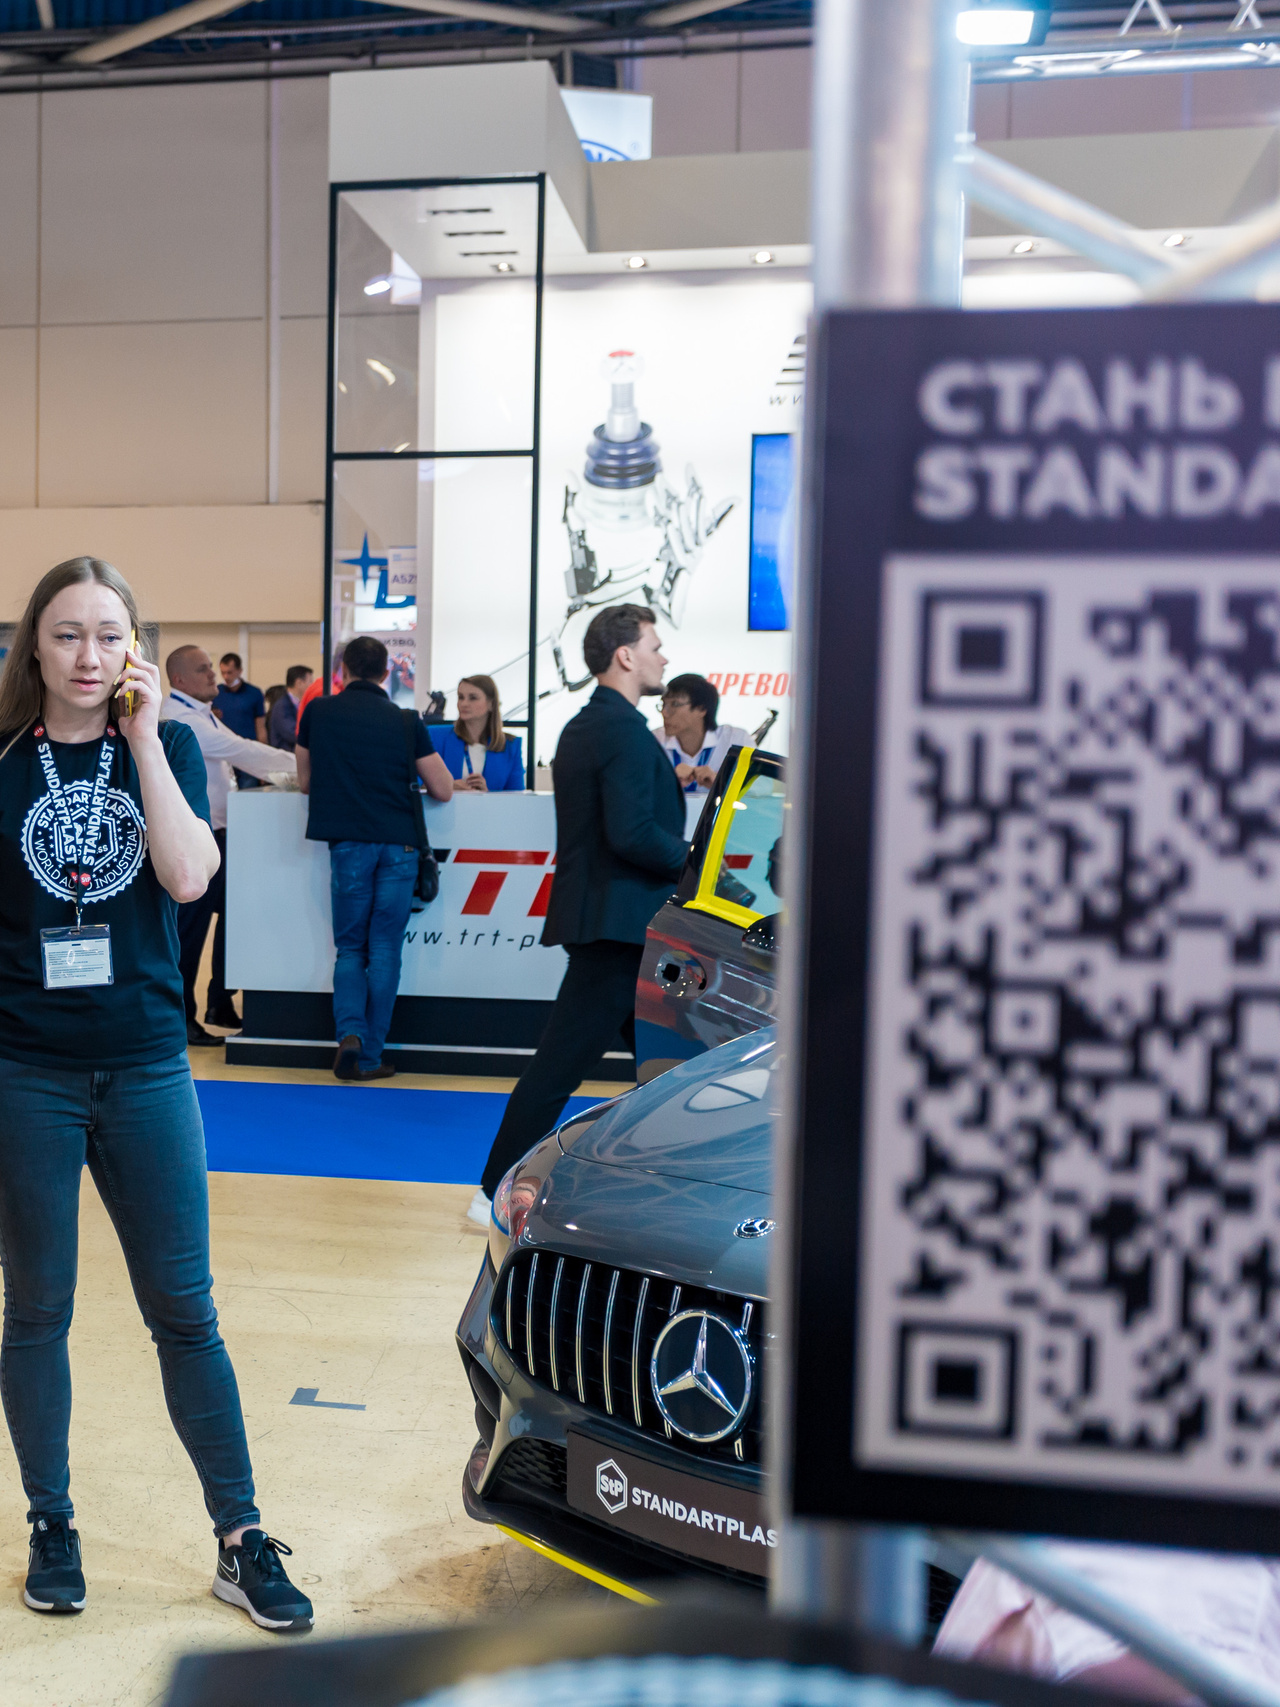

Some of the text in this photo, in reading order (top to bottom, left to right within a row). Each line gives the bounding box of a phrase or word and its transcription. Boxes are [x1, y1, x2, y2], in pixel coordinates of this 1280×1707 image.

[919, 357, 1244, 435] СТАНЬ
[38, 742, 78, 864] STANDARTPLAST
[82, 741, 115, 866] STANDARTPLAST
[34, 838, 61, 879] WORLD
[95, 827, 137, 889] INDUSTRIAL
[599, 1473, 624, 1498] StP
[631, 1486, 780, 1548] STANDARTPLAS
